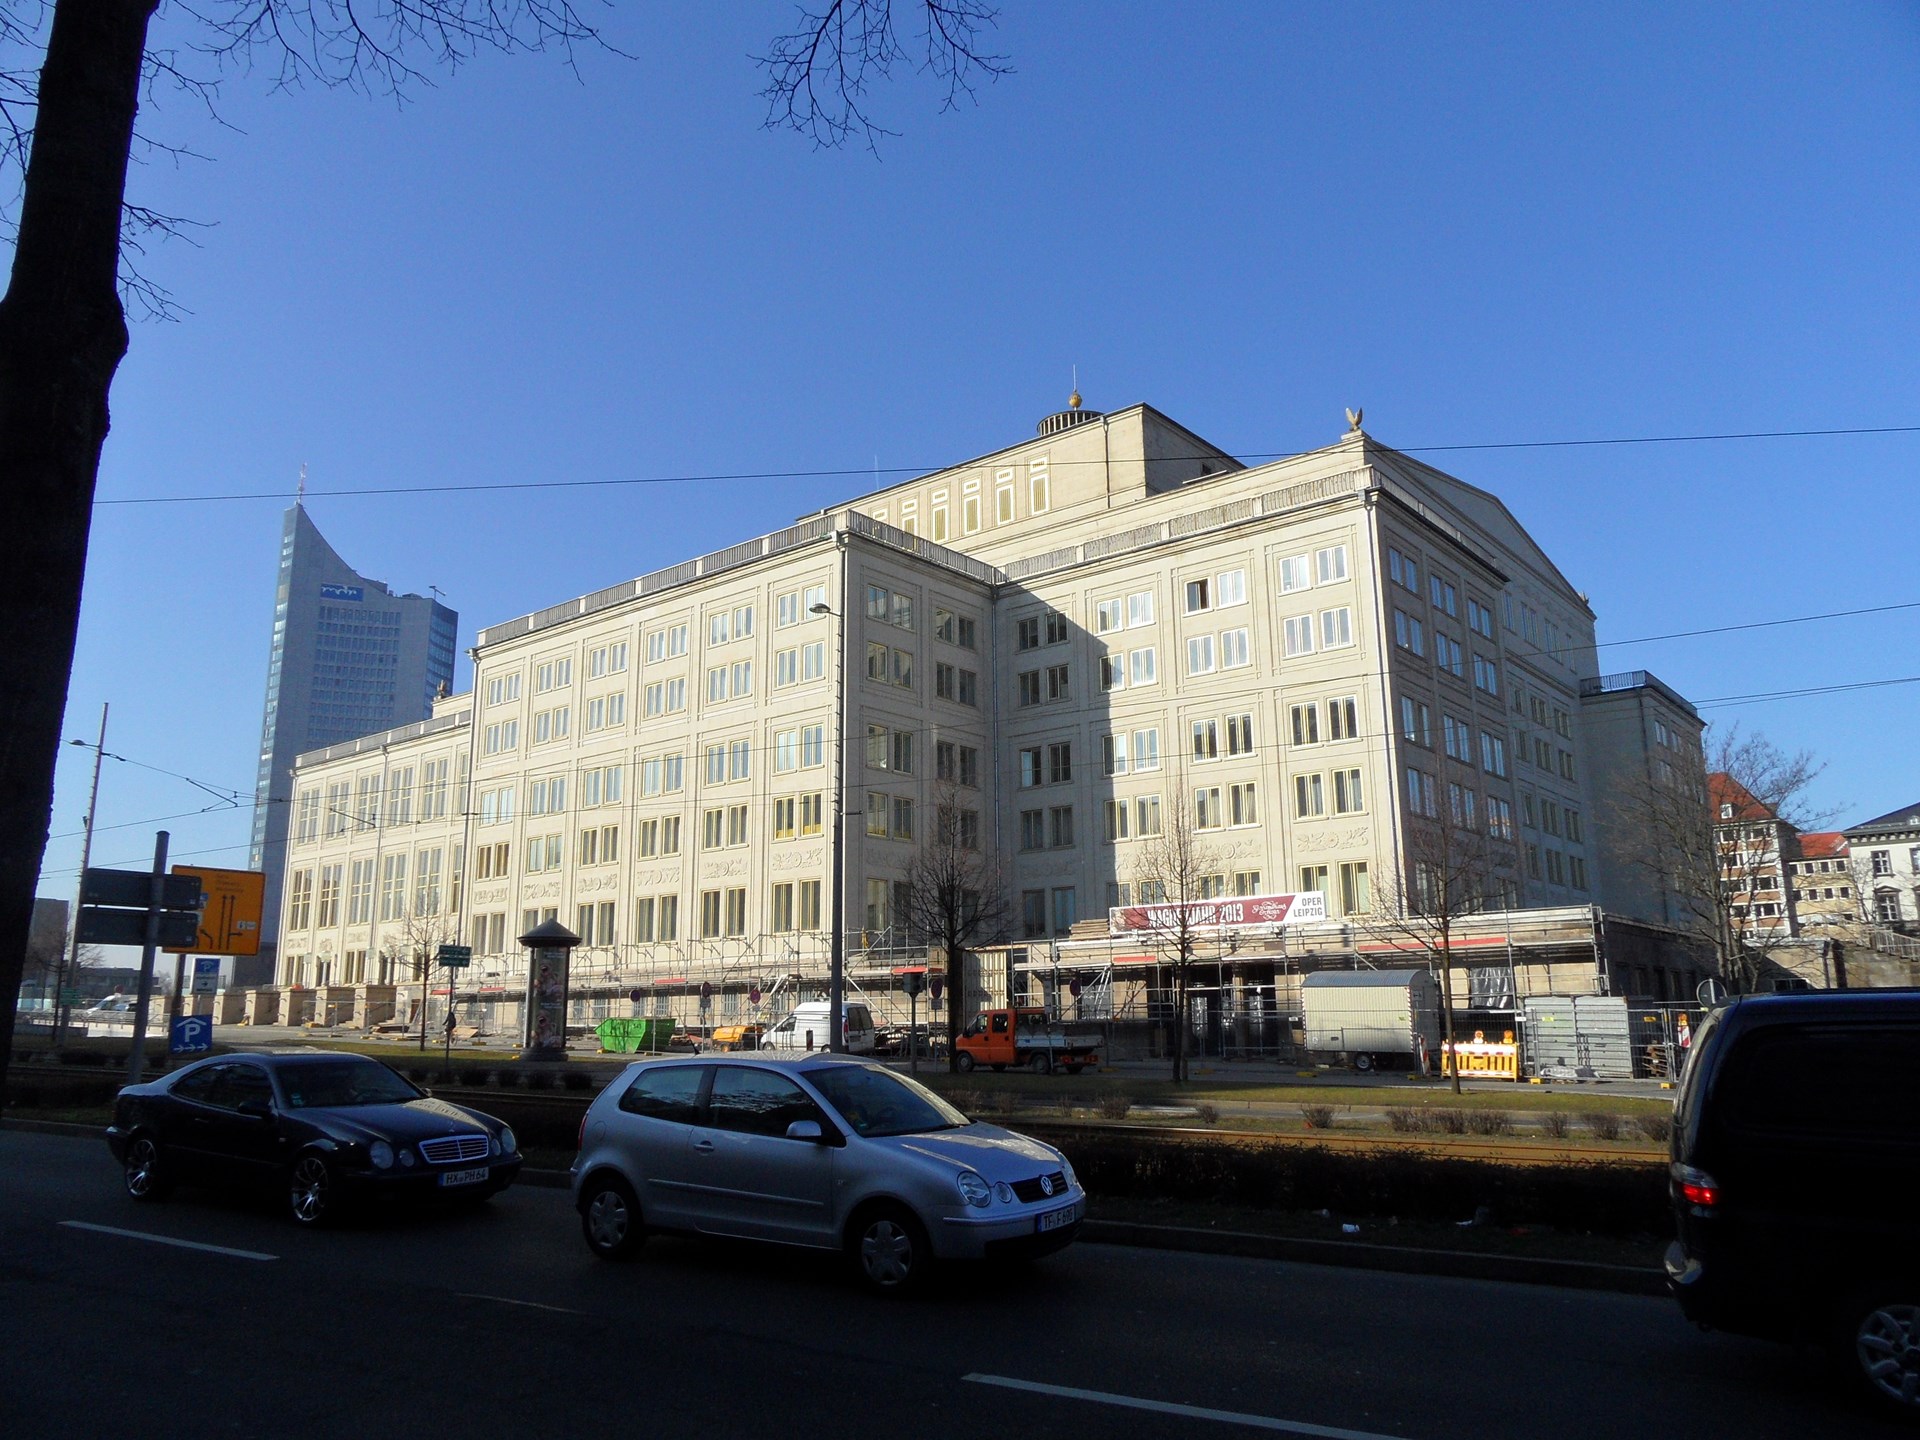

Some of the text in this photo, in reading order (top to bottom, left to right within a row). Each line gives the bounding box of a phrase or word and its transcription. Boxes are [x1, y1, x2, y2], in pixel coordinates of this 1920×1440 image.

[1302, 897, 1322, 907] OPER
[1219, 903, 1244, 923] 2013
[1293, 907, 1323, 918] LEIPZIG
[184, 1024, 201, 1043] P
